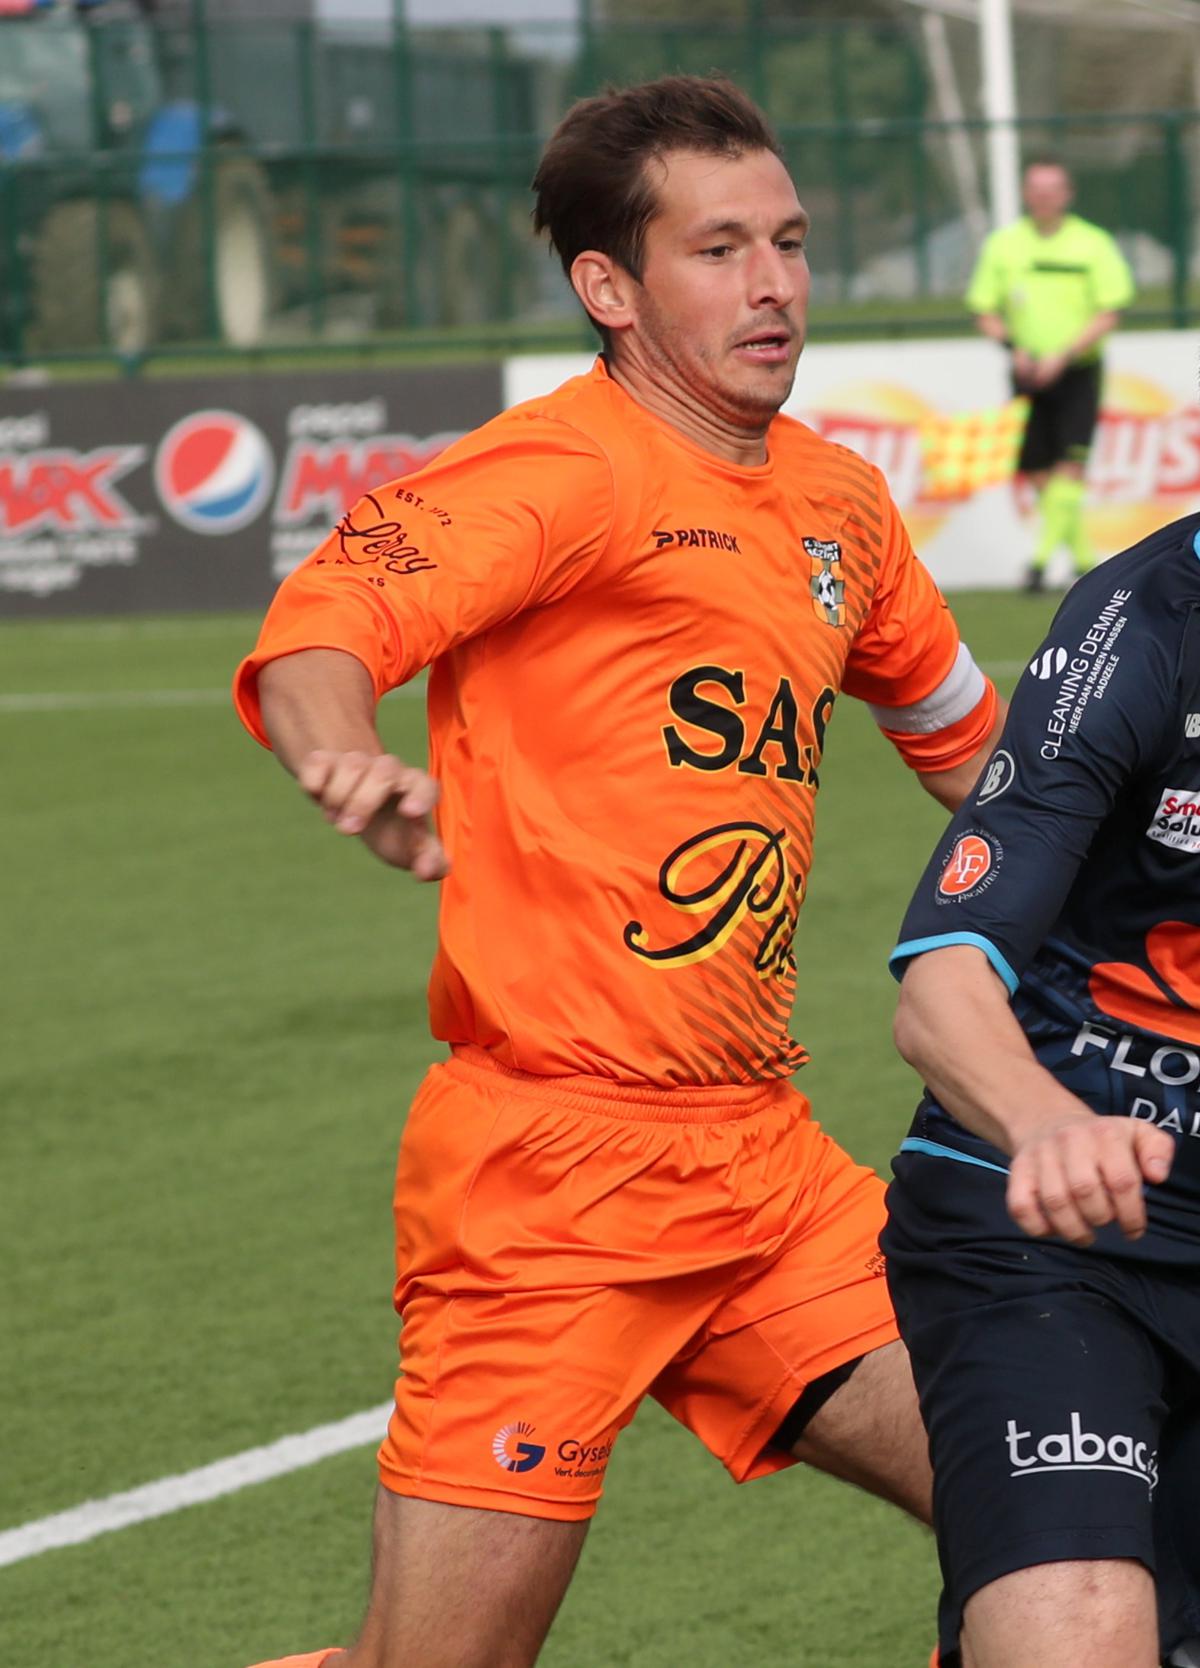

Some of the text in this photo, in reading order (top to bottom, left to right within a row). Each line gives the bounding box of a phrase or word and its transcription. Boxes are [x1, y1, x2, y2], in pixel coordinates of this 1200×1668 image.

[675, 528, 742, 555] PATRICK
[1040, 589, 1132, 760] CLEANING DEMINE
[1068, 616, 1128, 735] MEER DAN RAMEN WASSEN
[1093, 654, 1120, 700] DADIZELE
